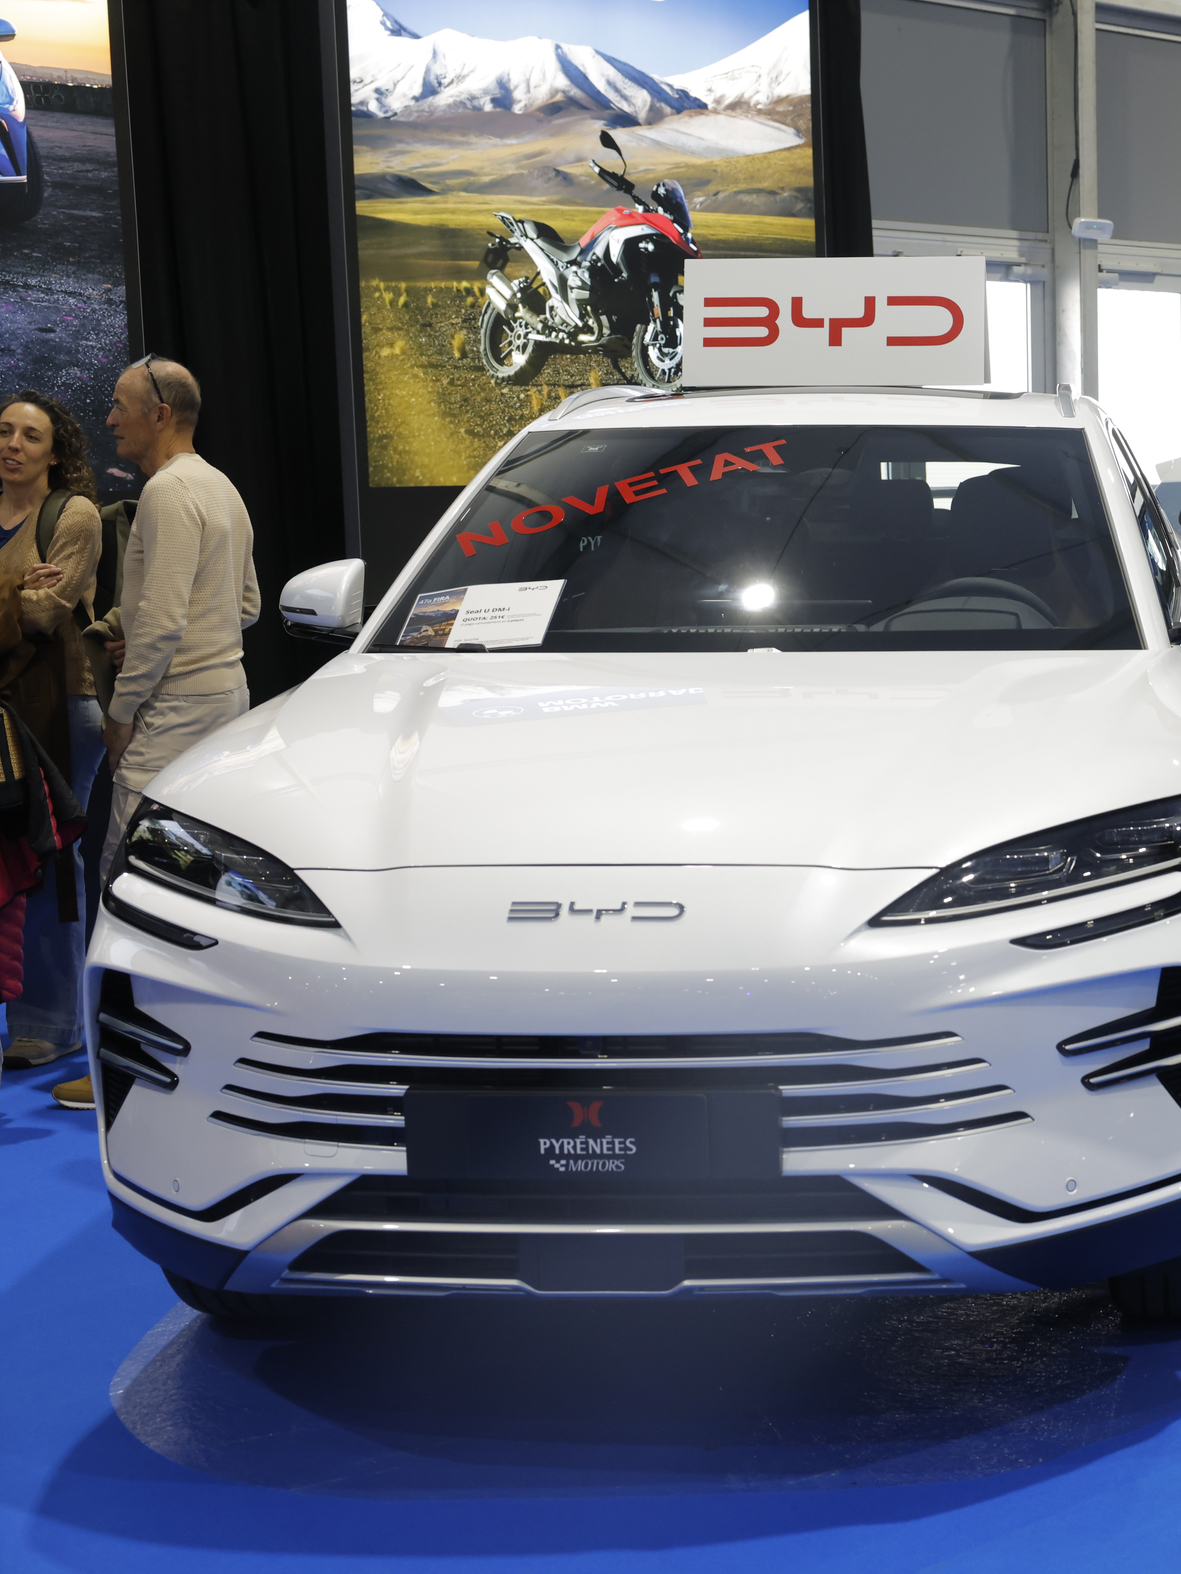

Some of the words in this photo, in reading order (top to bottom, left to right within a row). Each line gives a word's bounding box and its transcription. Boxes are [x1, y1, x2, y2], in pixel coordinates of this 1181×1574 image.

[703, 296, 964, 347] BYD
[456, 439, 787, 557] NOVETAT
[462, 615, 488, 623] QUOTA:
[507, 901, 685, 922] BYD
[568, 1159, 625, 1172] MOTORS
